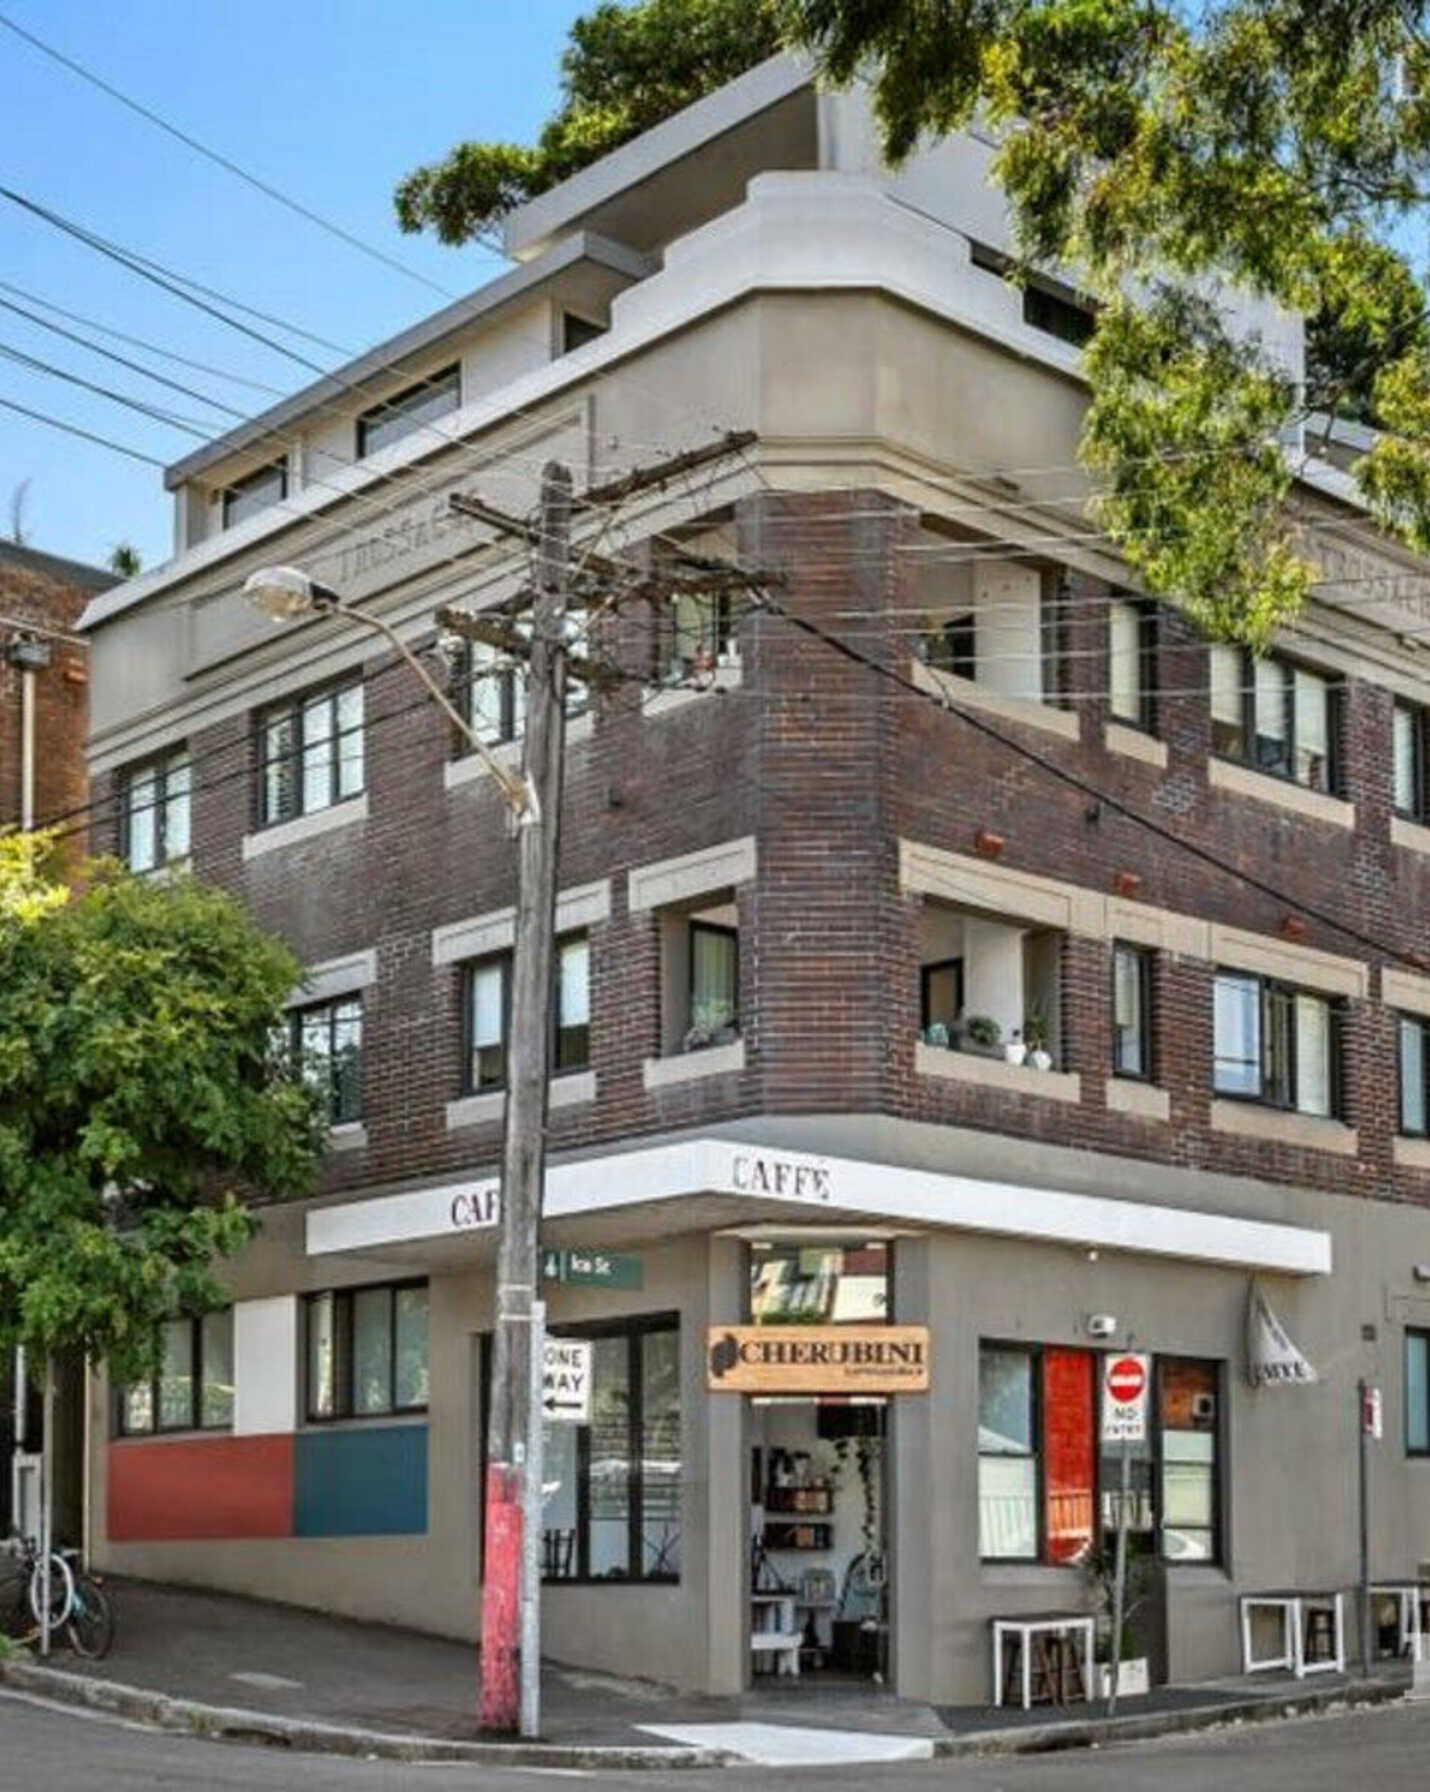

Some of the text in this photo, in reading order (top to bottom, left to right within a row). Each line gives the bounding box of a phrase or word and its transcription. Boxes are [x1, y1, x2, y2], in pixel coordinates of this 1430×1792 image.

[451, 1191, 500, 1227] CAF
[544, 1347, 583, 1369] ONE
[740, 1341, 923, 1364] CHERUBINI
[1113, 1406, 1138, 1421] NO
